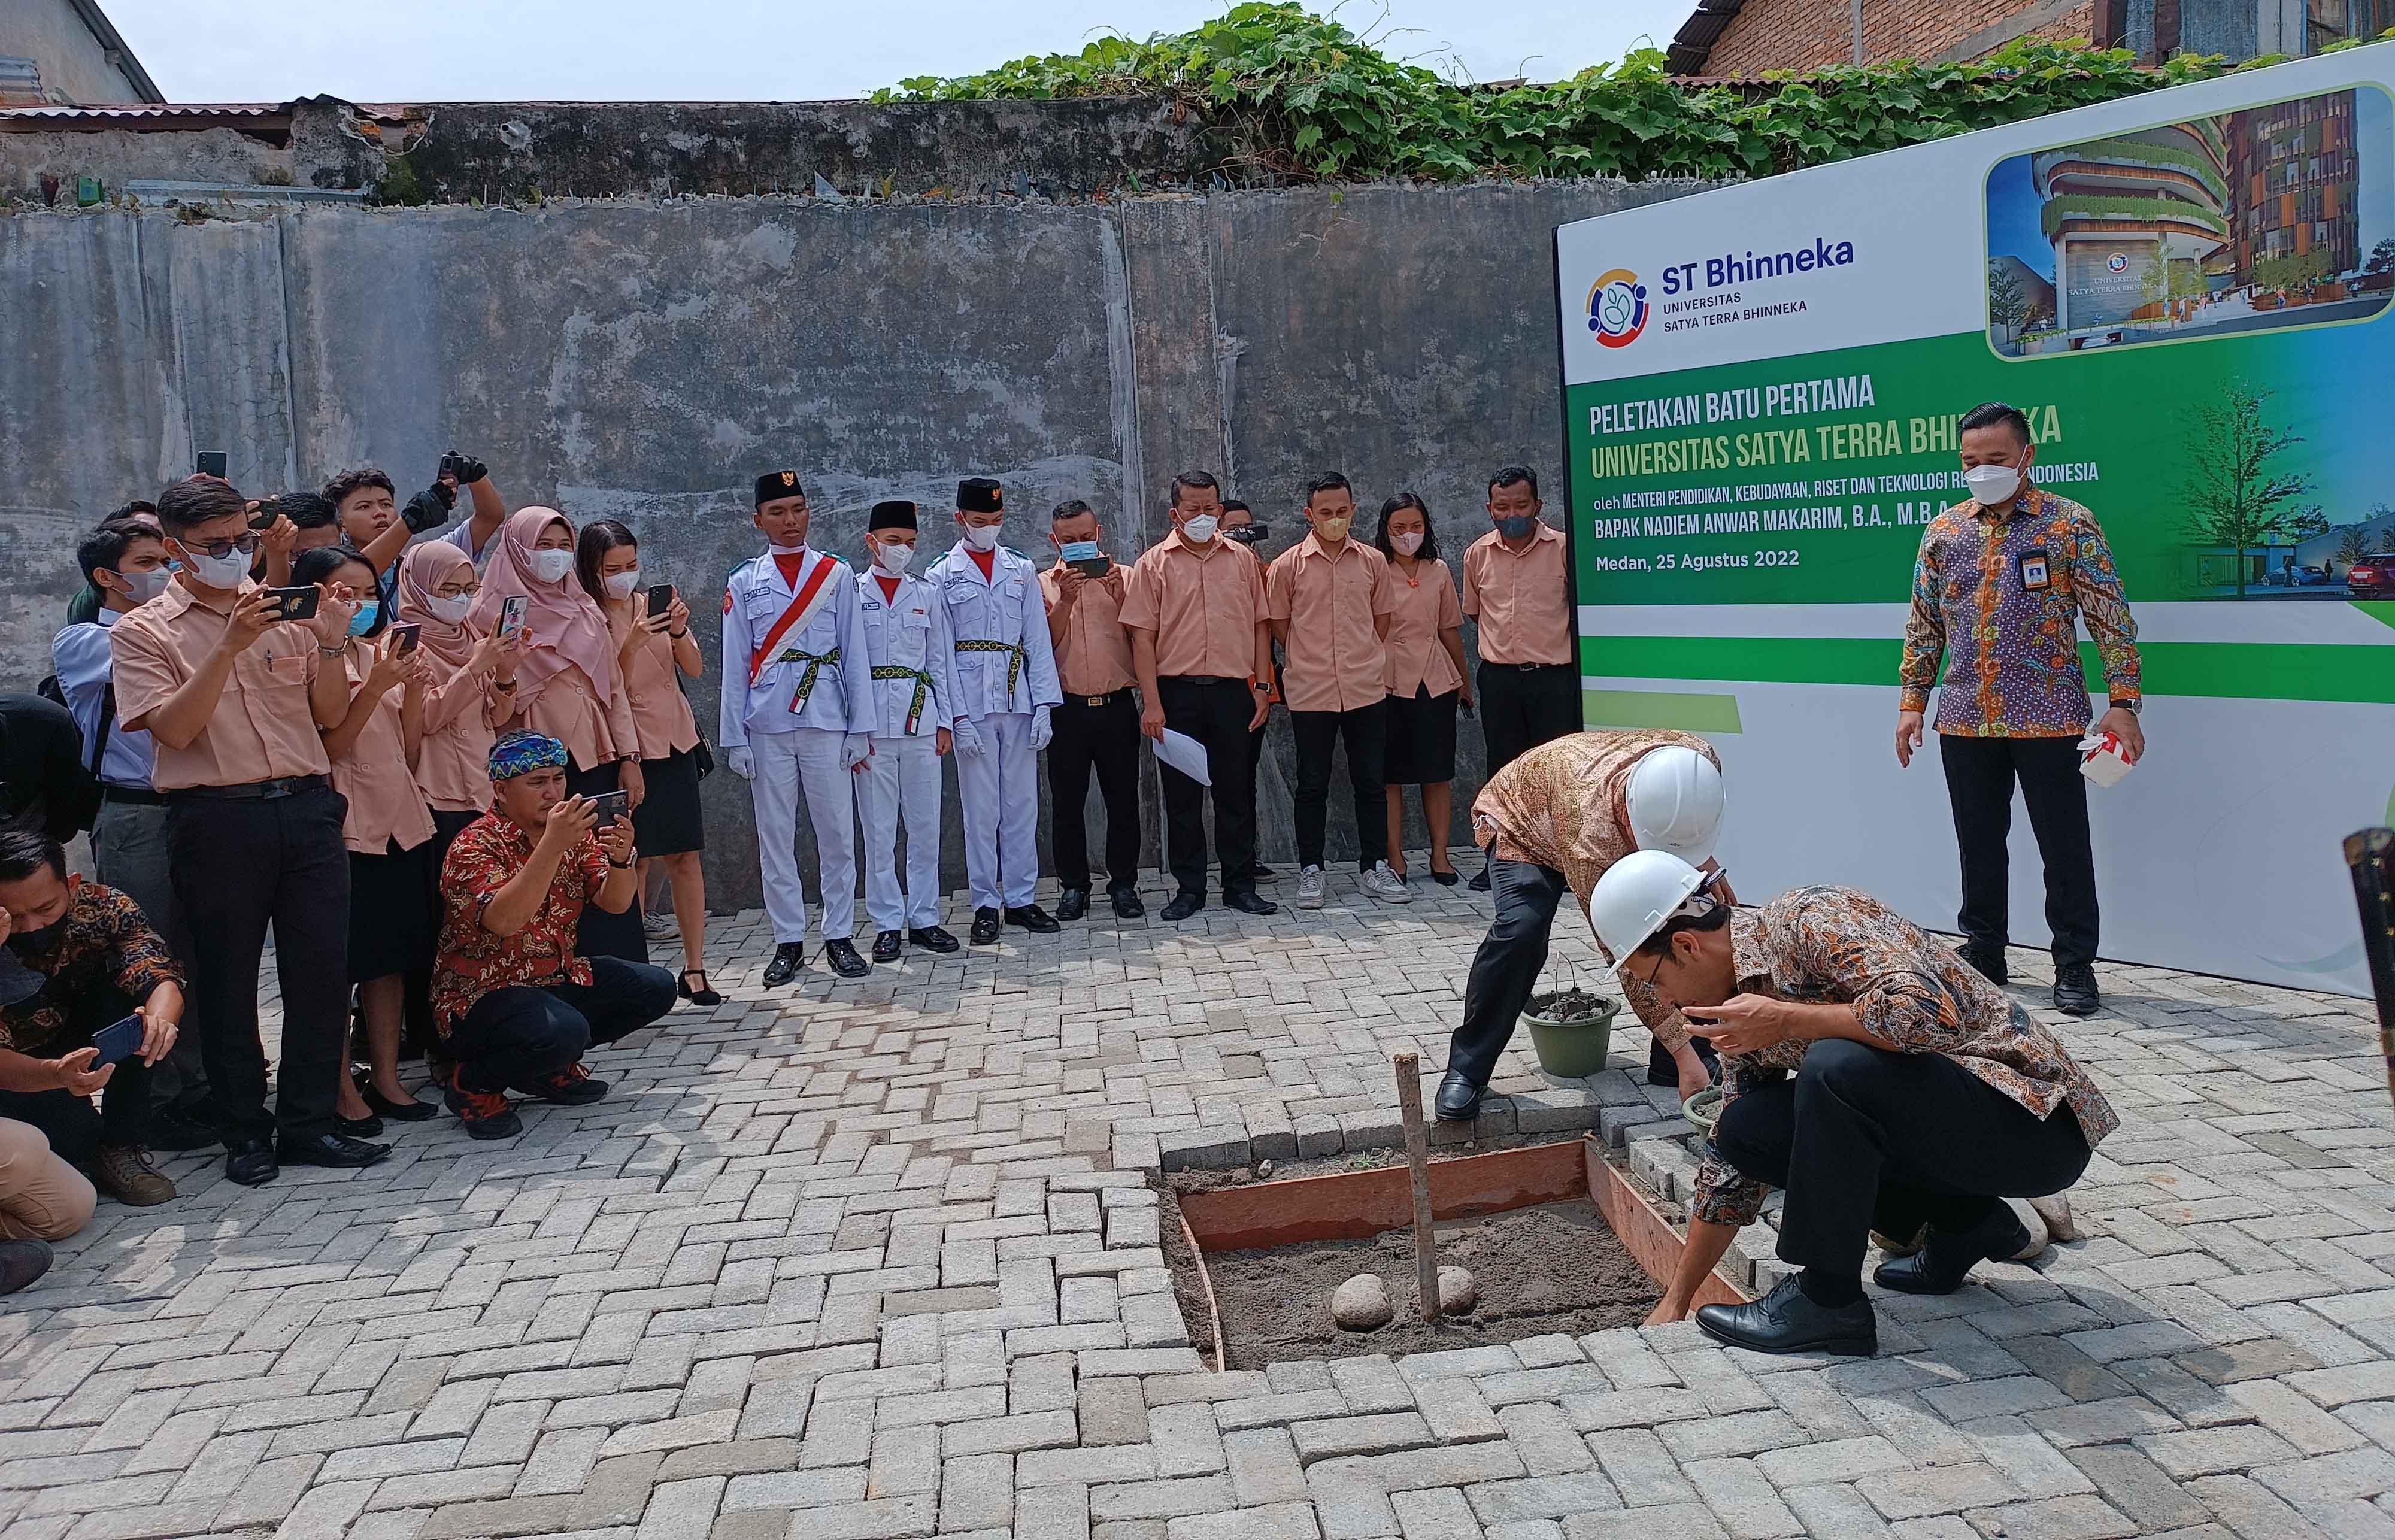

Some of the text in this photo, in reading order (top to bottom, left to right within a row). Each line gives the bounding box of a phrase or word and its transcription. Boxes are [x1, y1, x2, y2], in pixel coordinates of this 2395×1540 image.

[1662, 237, 1854, 295] ST Bhinneka
[1663, 291, 1741, 315] UNIVERSITAS
[1664, 300, 1807, 333] SATYA TERRA BHINNEKA
[1590, 374, 1875, 436] PELETAKAN BATU PERTAMA
[1591, 435, 1729, 479] UNIVERSITAS
[1736, 428, 1811, 468] SATYA
[1816, 419, 1902, 460] TERRA
[1594, 495, 1620, 511] oleh
[1622, 490, 1666, 510] MENTERI
[1668, 486, 1733, 507] PENDIDIKAN,
[1735, 481, 1812, 502] KEBUDAYAAN,
[1814, 478, 1847, 497] RISET
[1850, 476, 1875, 496] DAN
[1878, 472, 1948, 493] TEKNOLOGI
[1594, 516, 1641, 539] BAPAK
[1643, 513, 1700, 538] NADIEM
[1703, 510, 1759, 534] ANWAR
[1763, 506, 1848, 532] MAKARIM,
[1853, 504, 1892, 530] B.A.,
[1596, 550, 1800, 574] Medan, 25 Agustus 2022
